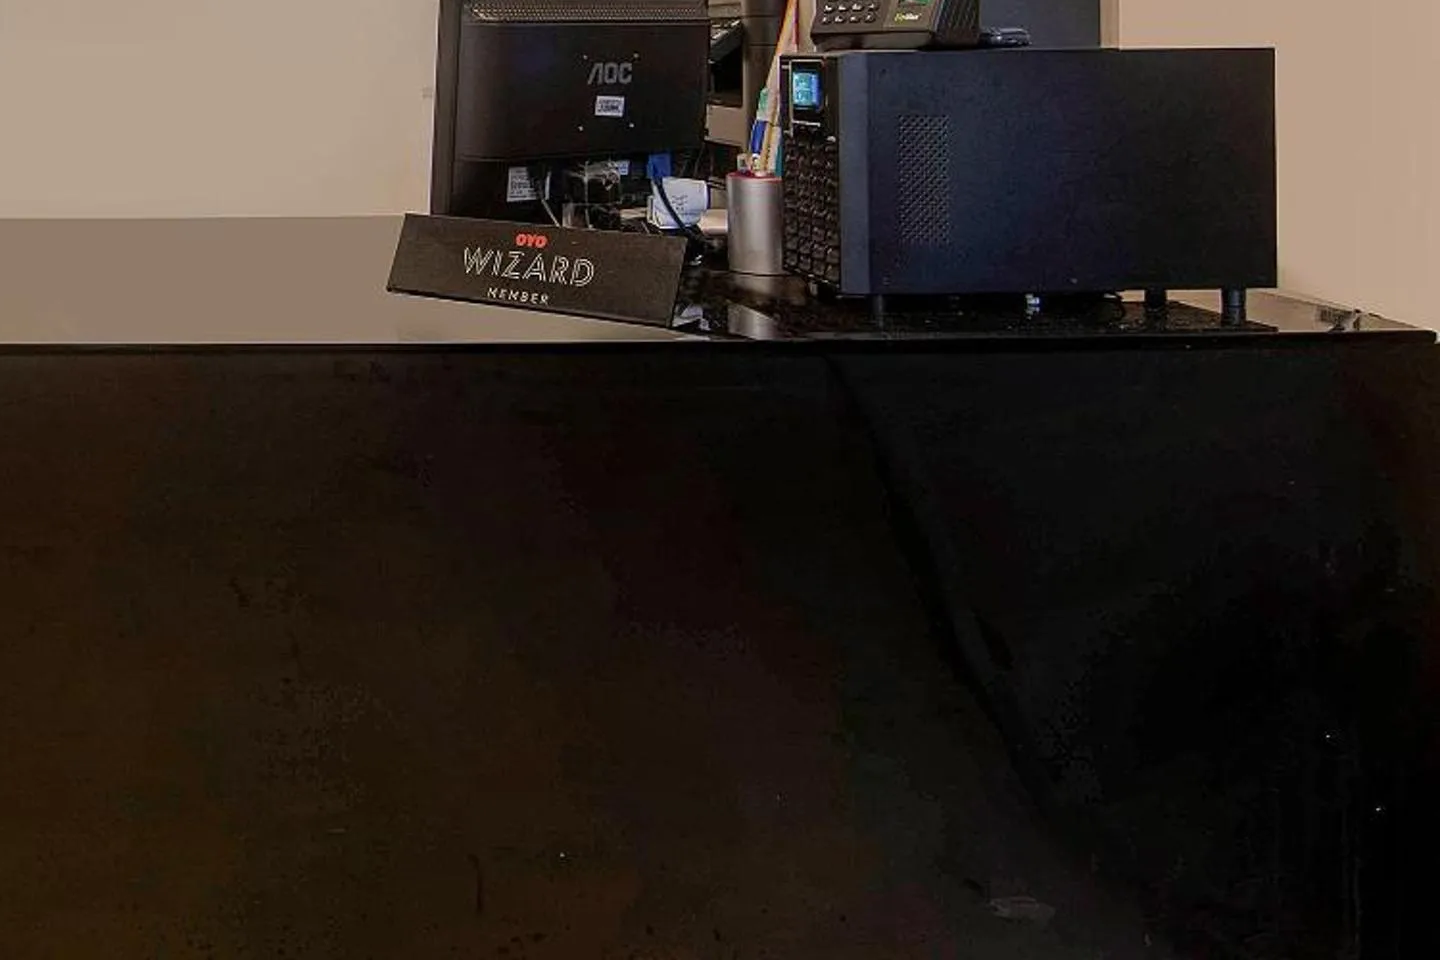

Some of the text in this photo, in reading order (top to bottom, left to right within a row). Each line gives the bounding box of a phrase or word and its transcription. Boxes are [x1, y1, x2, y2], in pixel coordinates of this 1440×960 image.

[587, 62, 633, 85] AOC
[515, 233, 548, 248] OYO
[463, 246, 595, 287] WIZARD
[487, 287, 550, 306] MEMBER
